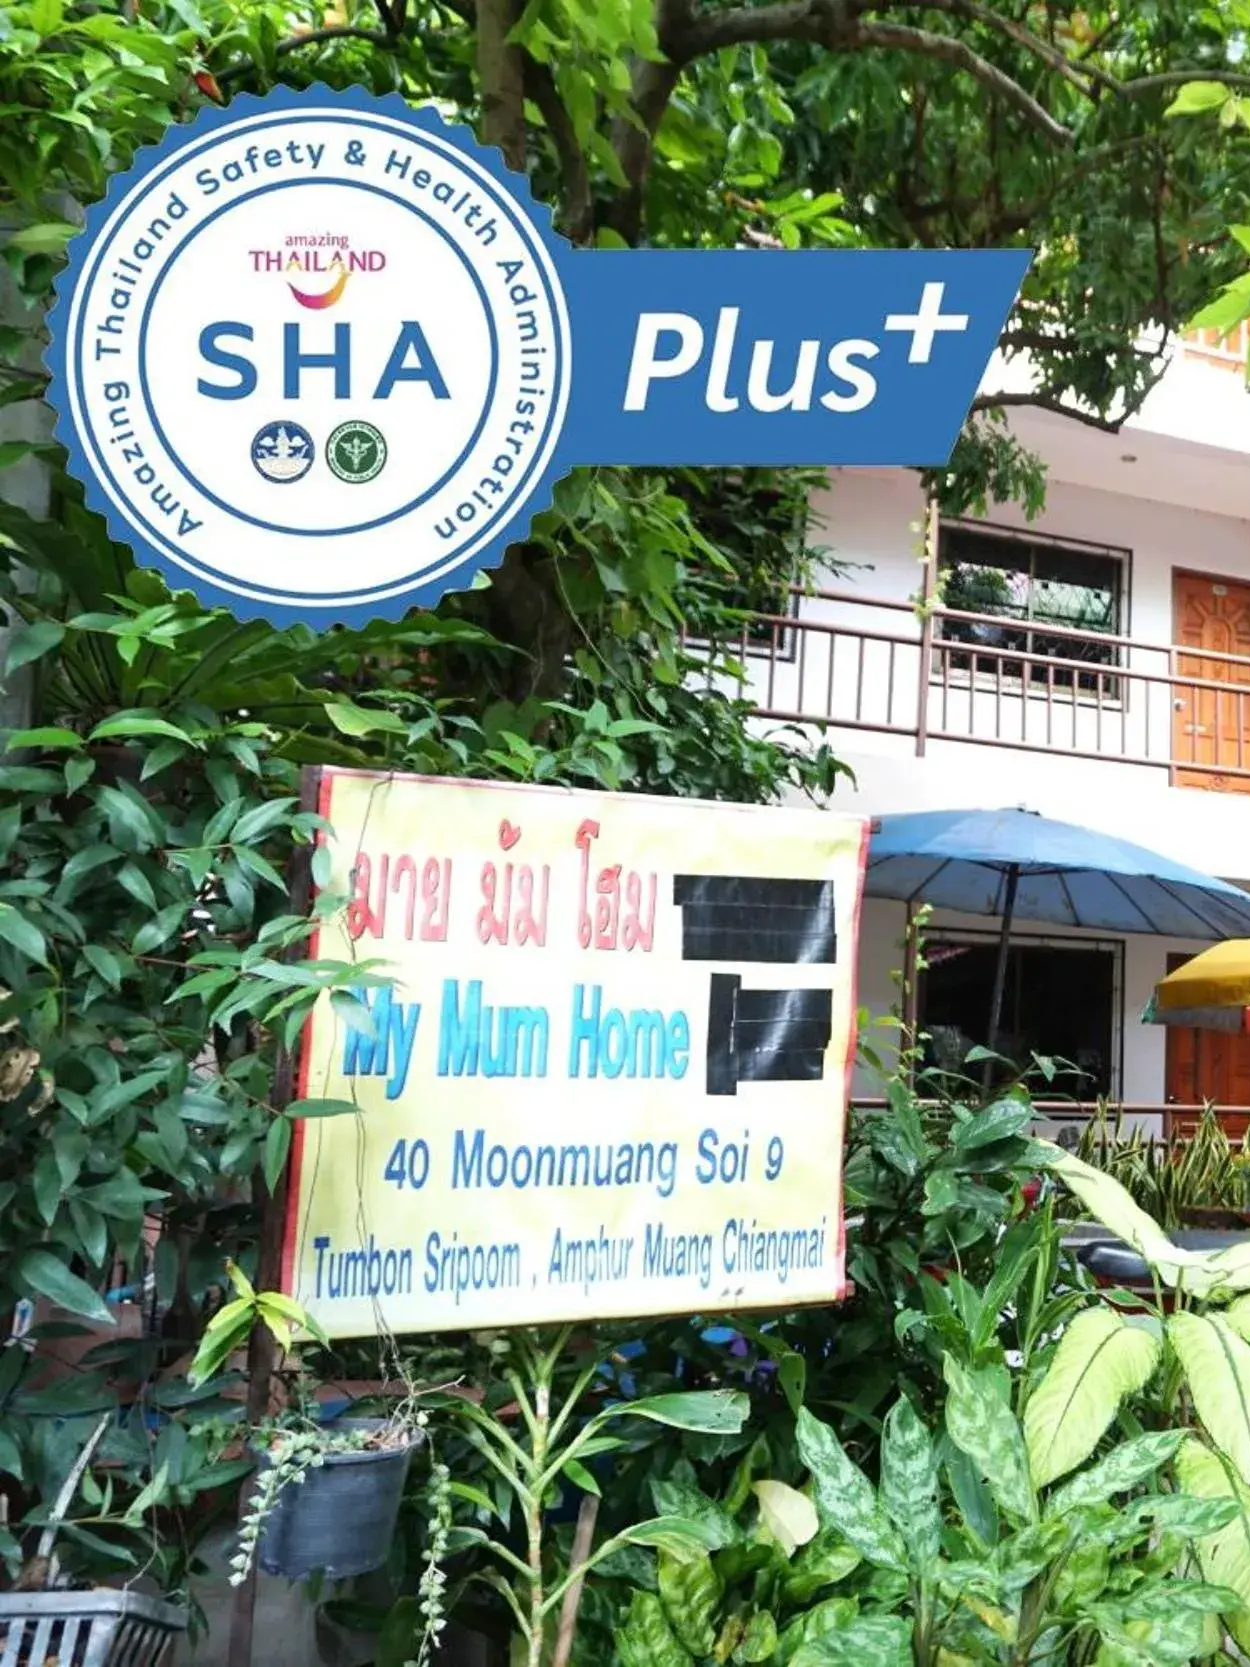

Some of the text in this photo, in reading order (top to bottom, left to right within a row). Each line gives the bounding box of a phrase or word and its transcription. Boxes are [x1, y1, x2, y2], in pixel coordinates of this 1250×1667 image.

[347, 851, 452, 942] มาย
[343, 978, 691, 1101] My Mum Home
[384, 1128, 784, 1198] 40 Moonmuang Soi 9
[313, 1233, 412, 1299] Tumbon
[424, 1230, 520, 1306] Sripoom
[548, 1224, 634, 1297] Amphur
[643, 1221, 713, 1289] Muang
[722, 1216, 827, 1284] Chiangmai
